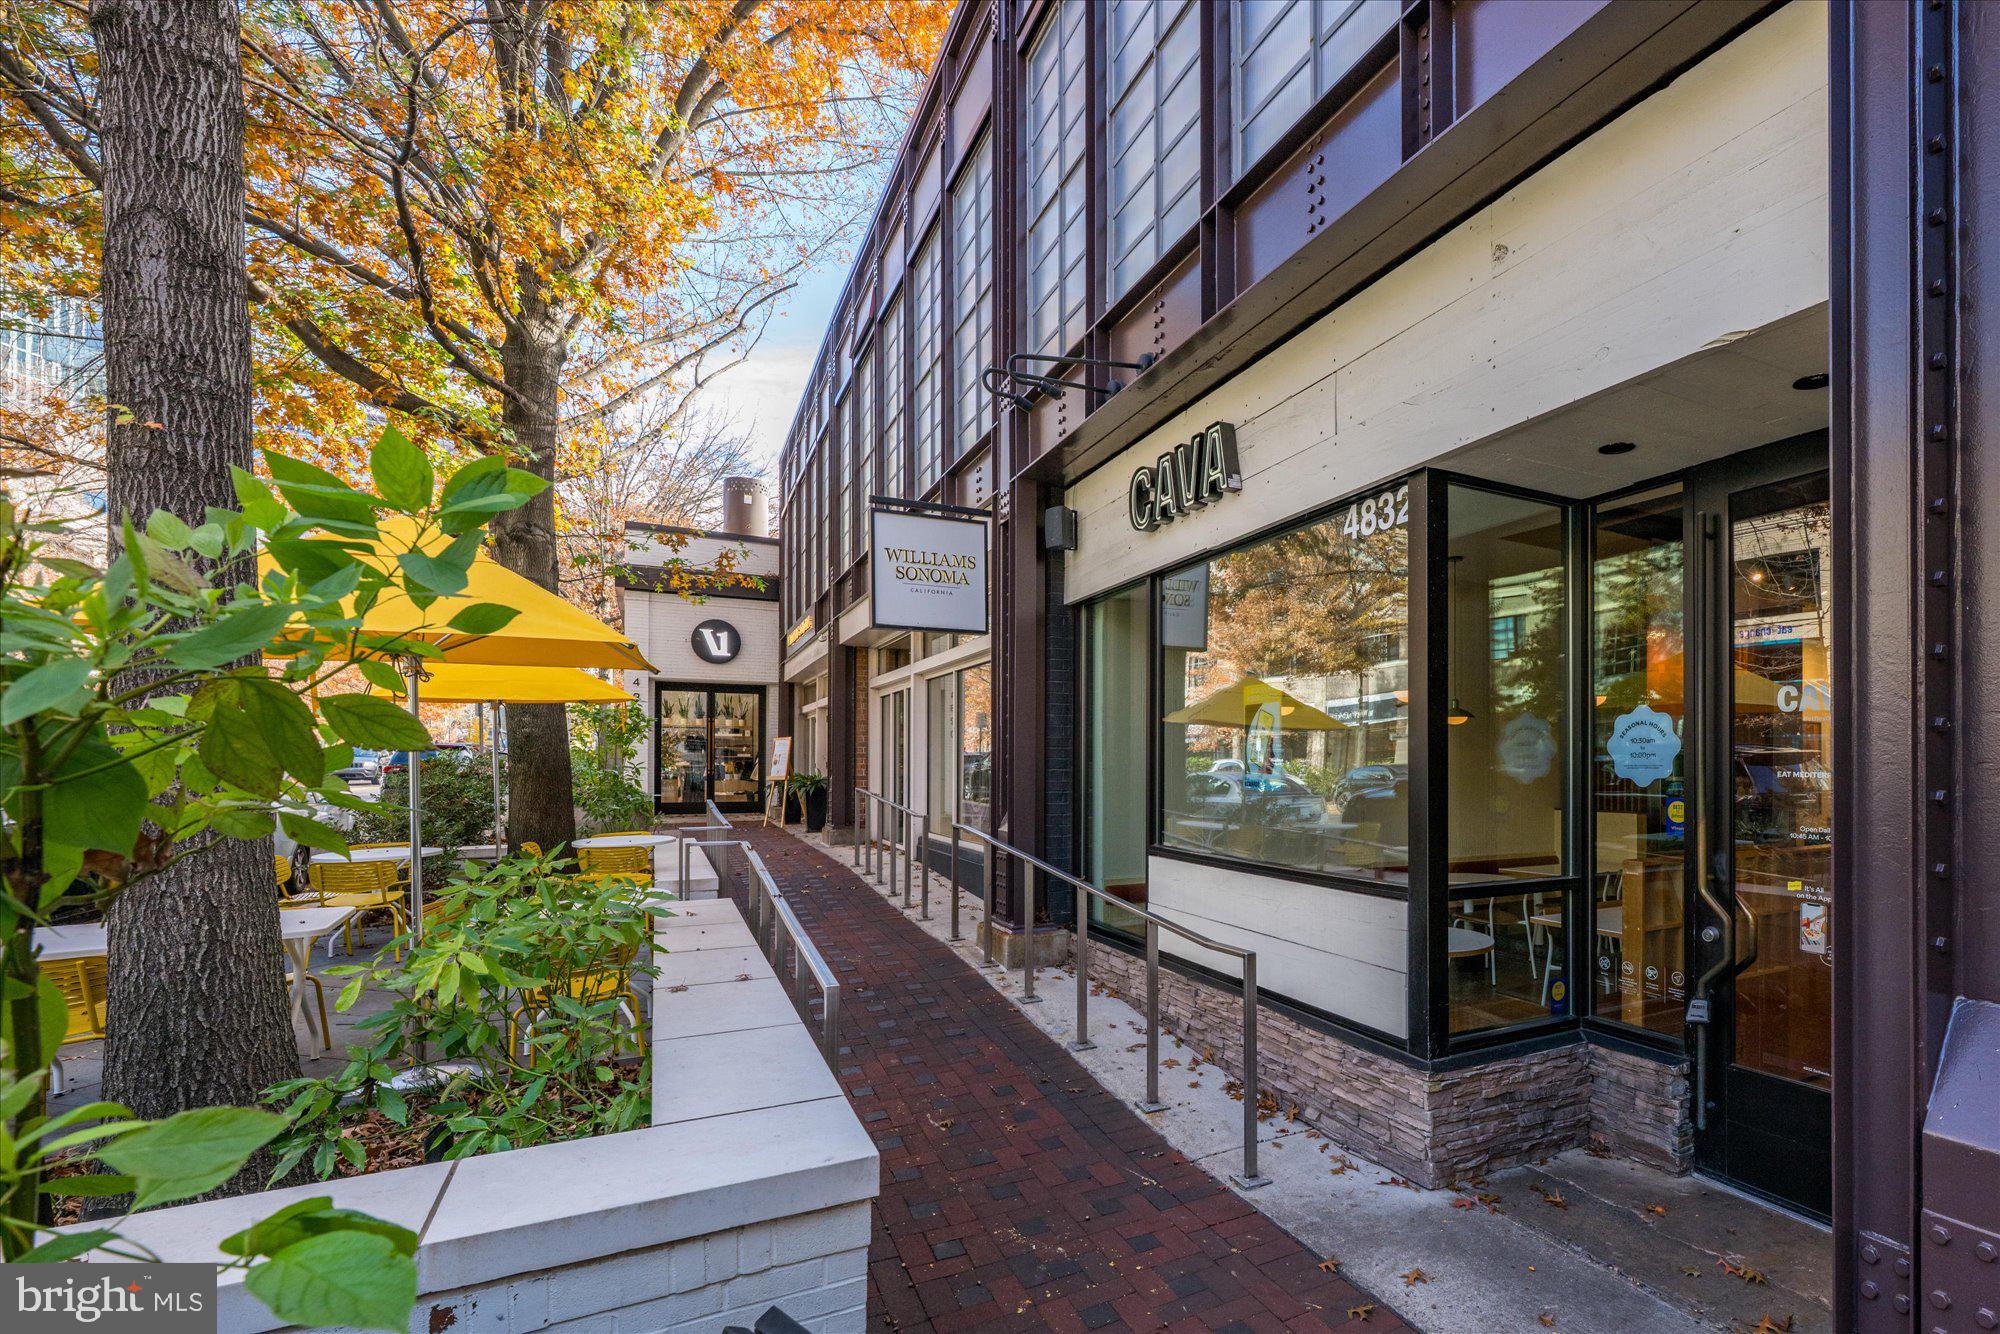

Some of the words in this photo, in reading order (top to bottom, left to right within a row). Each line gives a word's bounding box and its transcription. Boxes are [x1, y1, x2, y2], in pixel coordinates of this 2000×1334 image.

[1129, 421, 1240, 532] CAVA
[1344, 485, 1408, 539] 4832
[884, 547, 977, 570] WILLIAMS
[895, 565, 970, 586] SONOMA
[910, 587, 953, 596] CALIFORNIA
[1619, 720, 1648, 739] SEASONAL
[1648, 720, 1667, 738] HOURS
[1800, 825, 1818, 833] Open
[1804, 885, 1815, 893] It's
[1815, 886, 1825, 894] All
[1805, 893, 1817, 901] the
[1818, 895, 1832, 903] App
